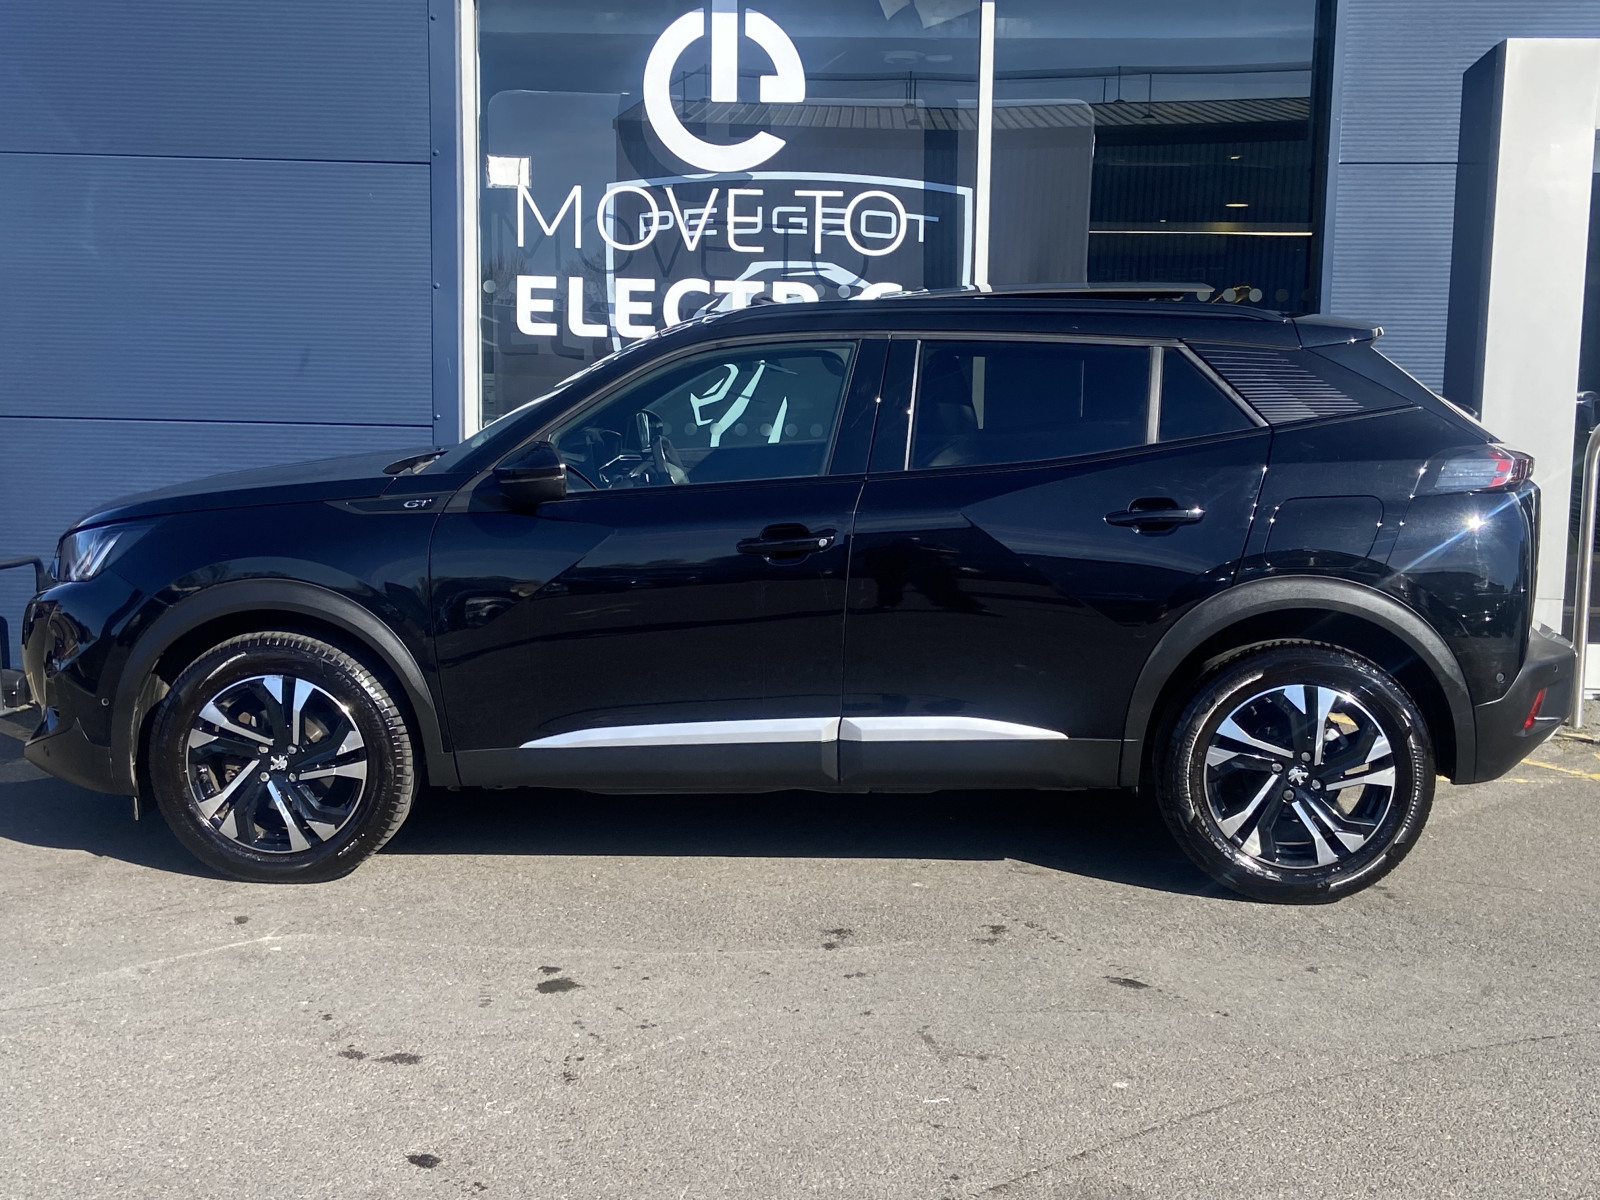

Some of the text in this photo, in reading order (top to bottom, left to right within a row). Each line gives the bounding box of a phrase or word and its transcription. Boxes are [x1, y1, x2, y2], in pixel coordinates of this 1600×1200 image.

[516, 184, 908, 257] MOVE TO
[638, 205, 940, 244] PEUGEOT
[403, 498, 432, 508] GT
